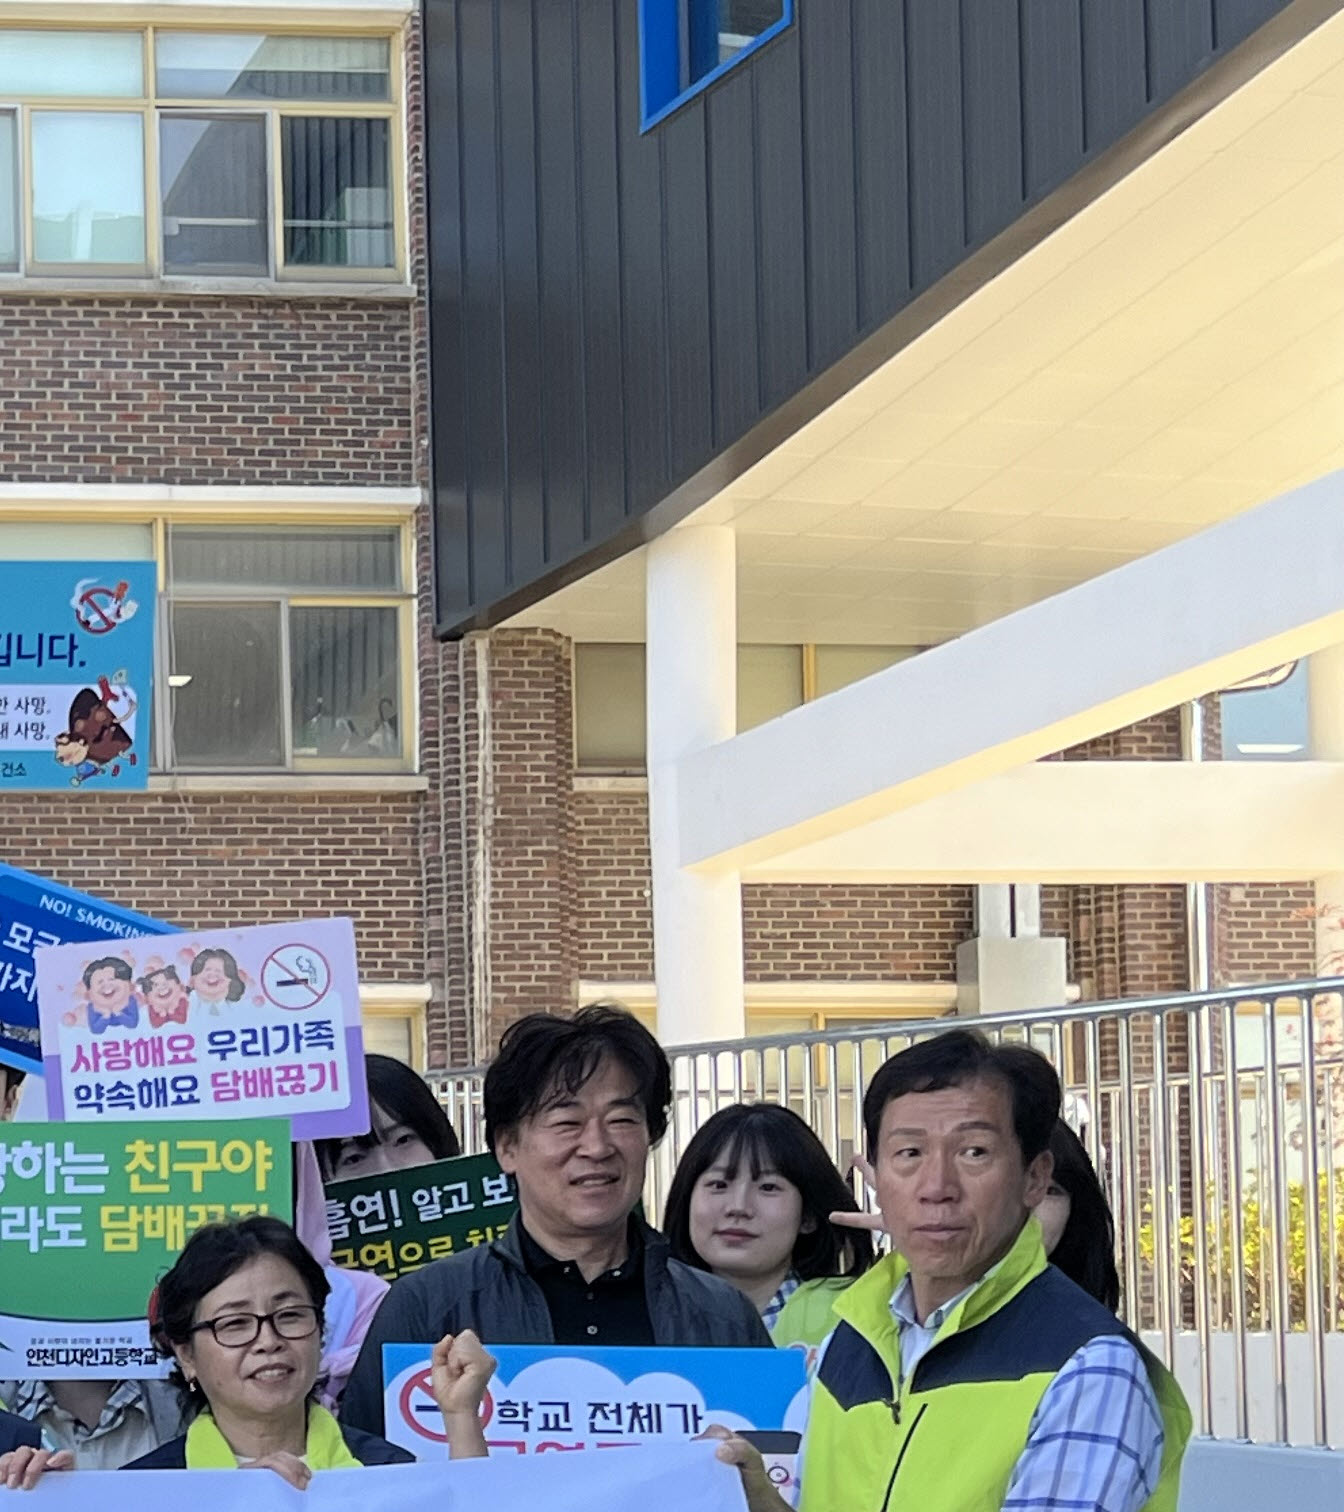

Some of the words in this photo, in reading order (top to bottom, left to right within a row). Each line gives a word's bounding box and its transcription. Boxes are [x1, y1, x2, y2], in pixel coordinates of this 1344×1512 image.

[39, 894, 71, 917] NO!
[71, 1034, 196, 1074] 사랑해요
[207, 1020, 335, 1062] 우리가족
[74, 1074, 200, 1114] 약속해요
[211, 1060, 339, 1102] 담배끊기
[124, 1139, 273, 1194] 친구야
[412, 1181, 475, 1223] 알고
[26, 1348, 158, 1367] 인천디자인고등학교
[497, 1399, 573, 1433] 학교
[587, 1401, 704, 1435] 전체가
